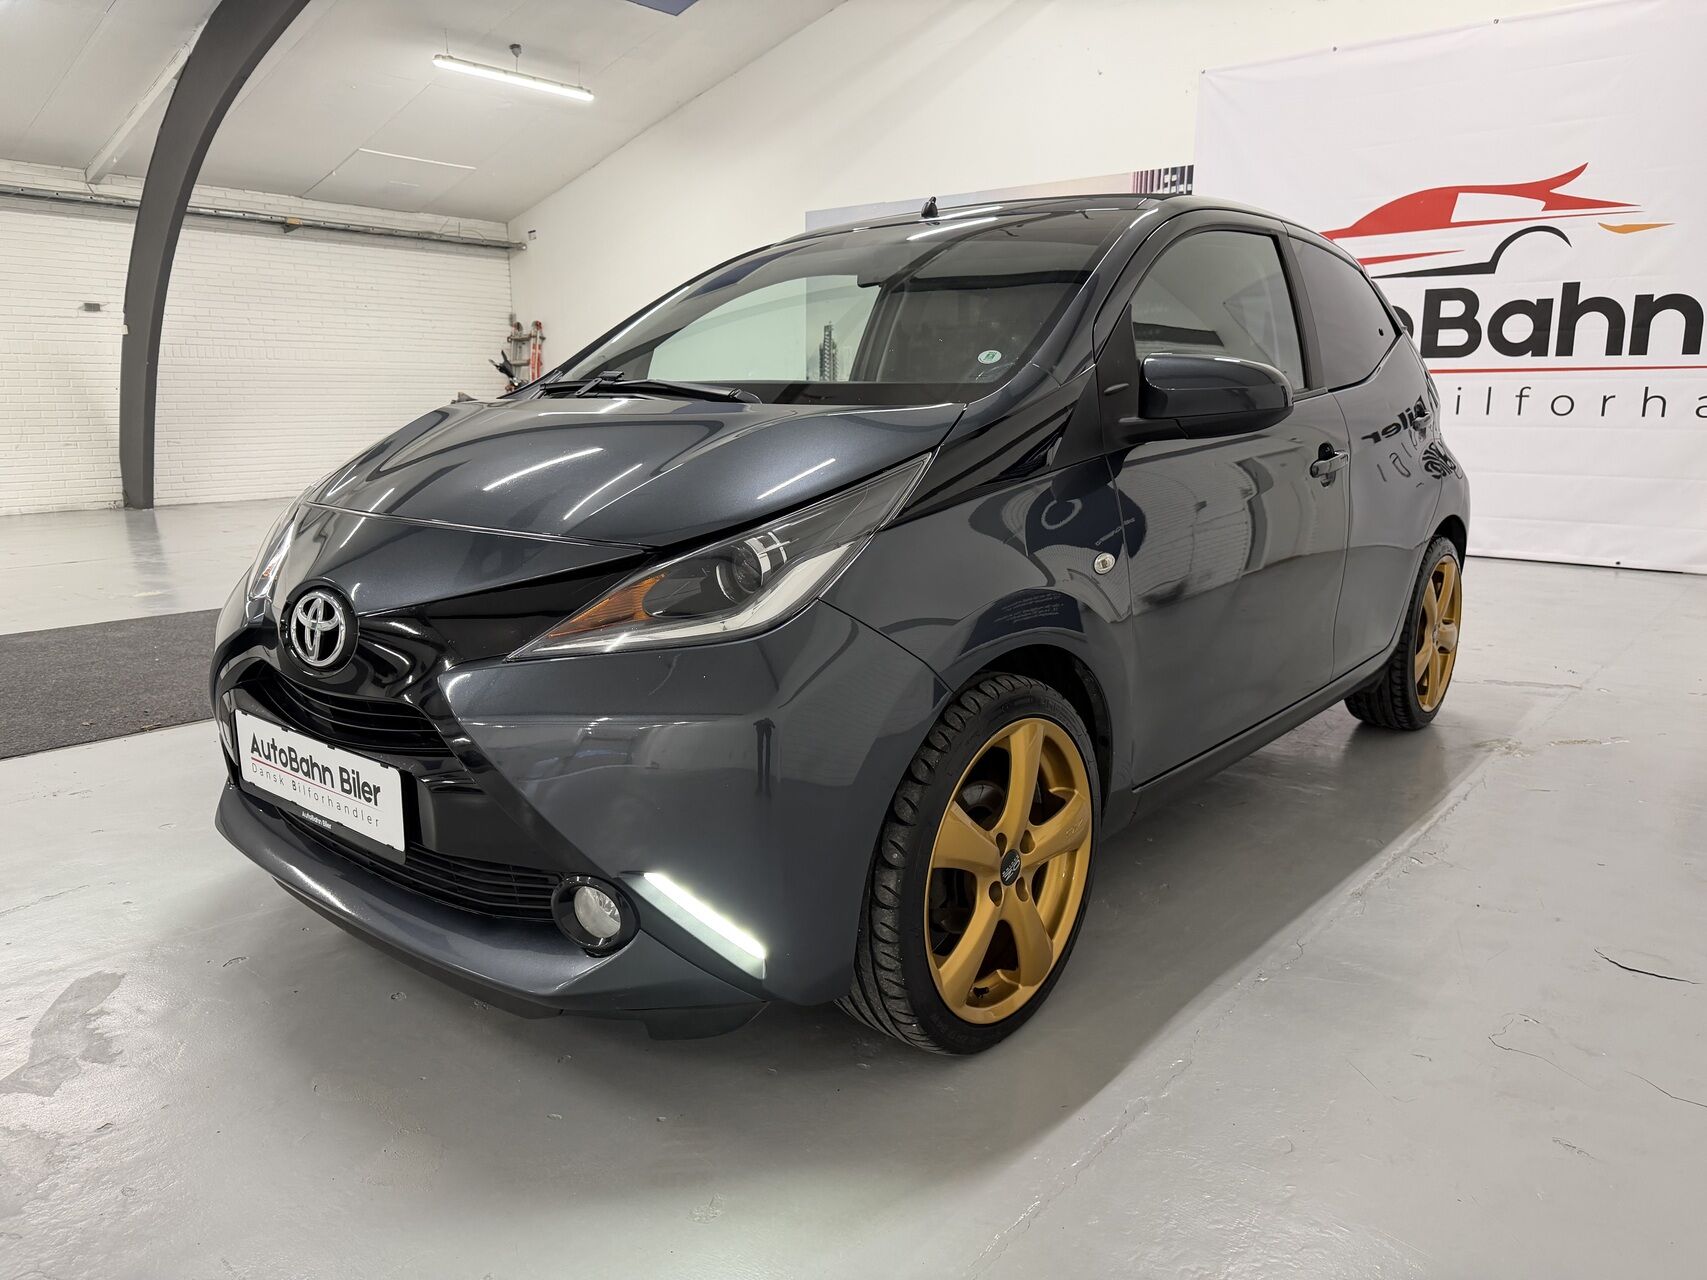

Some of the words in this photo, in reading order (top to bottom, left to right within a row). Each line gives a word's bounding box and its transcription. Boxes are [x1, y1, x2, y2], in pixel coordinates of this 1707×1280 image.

[251, 733, 335, 788] AutoBahn
[338, 766, 381, 806] Biler
[252, 762, 285, 786] Dansk
[292, 780, 380, 827] Bilforhandler
